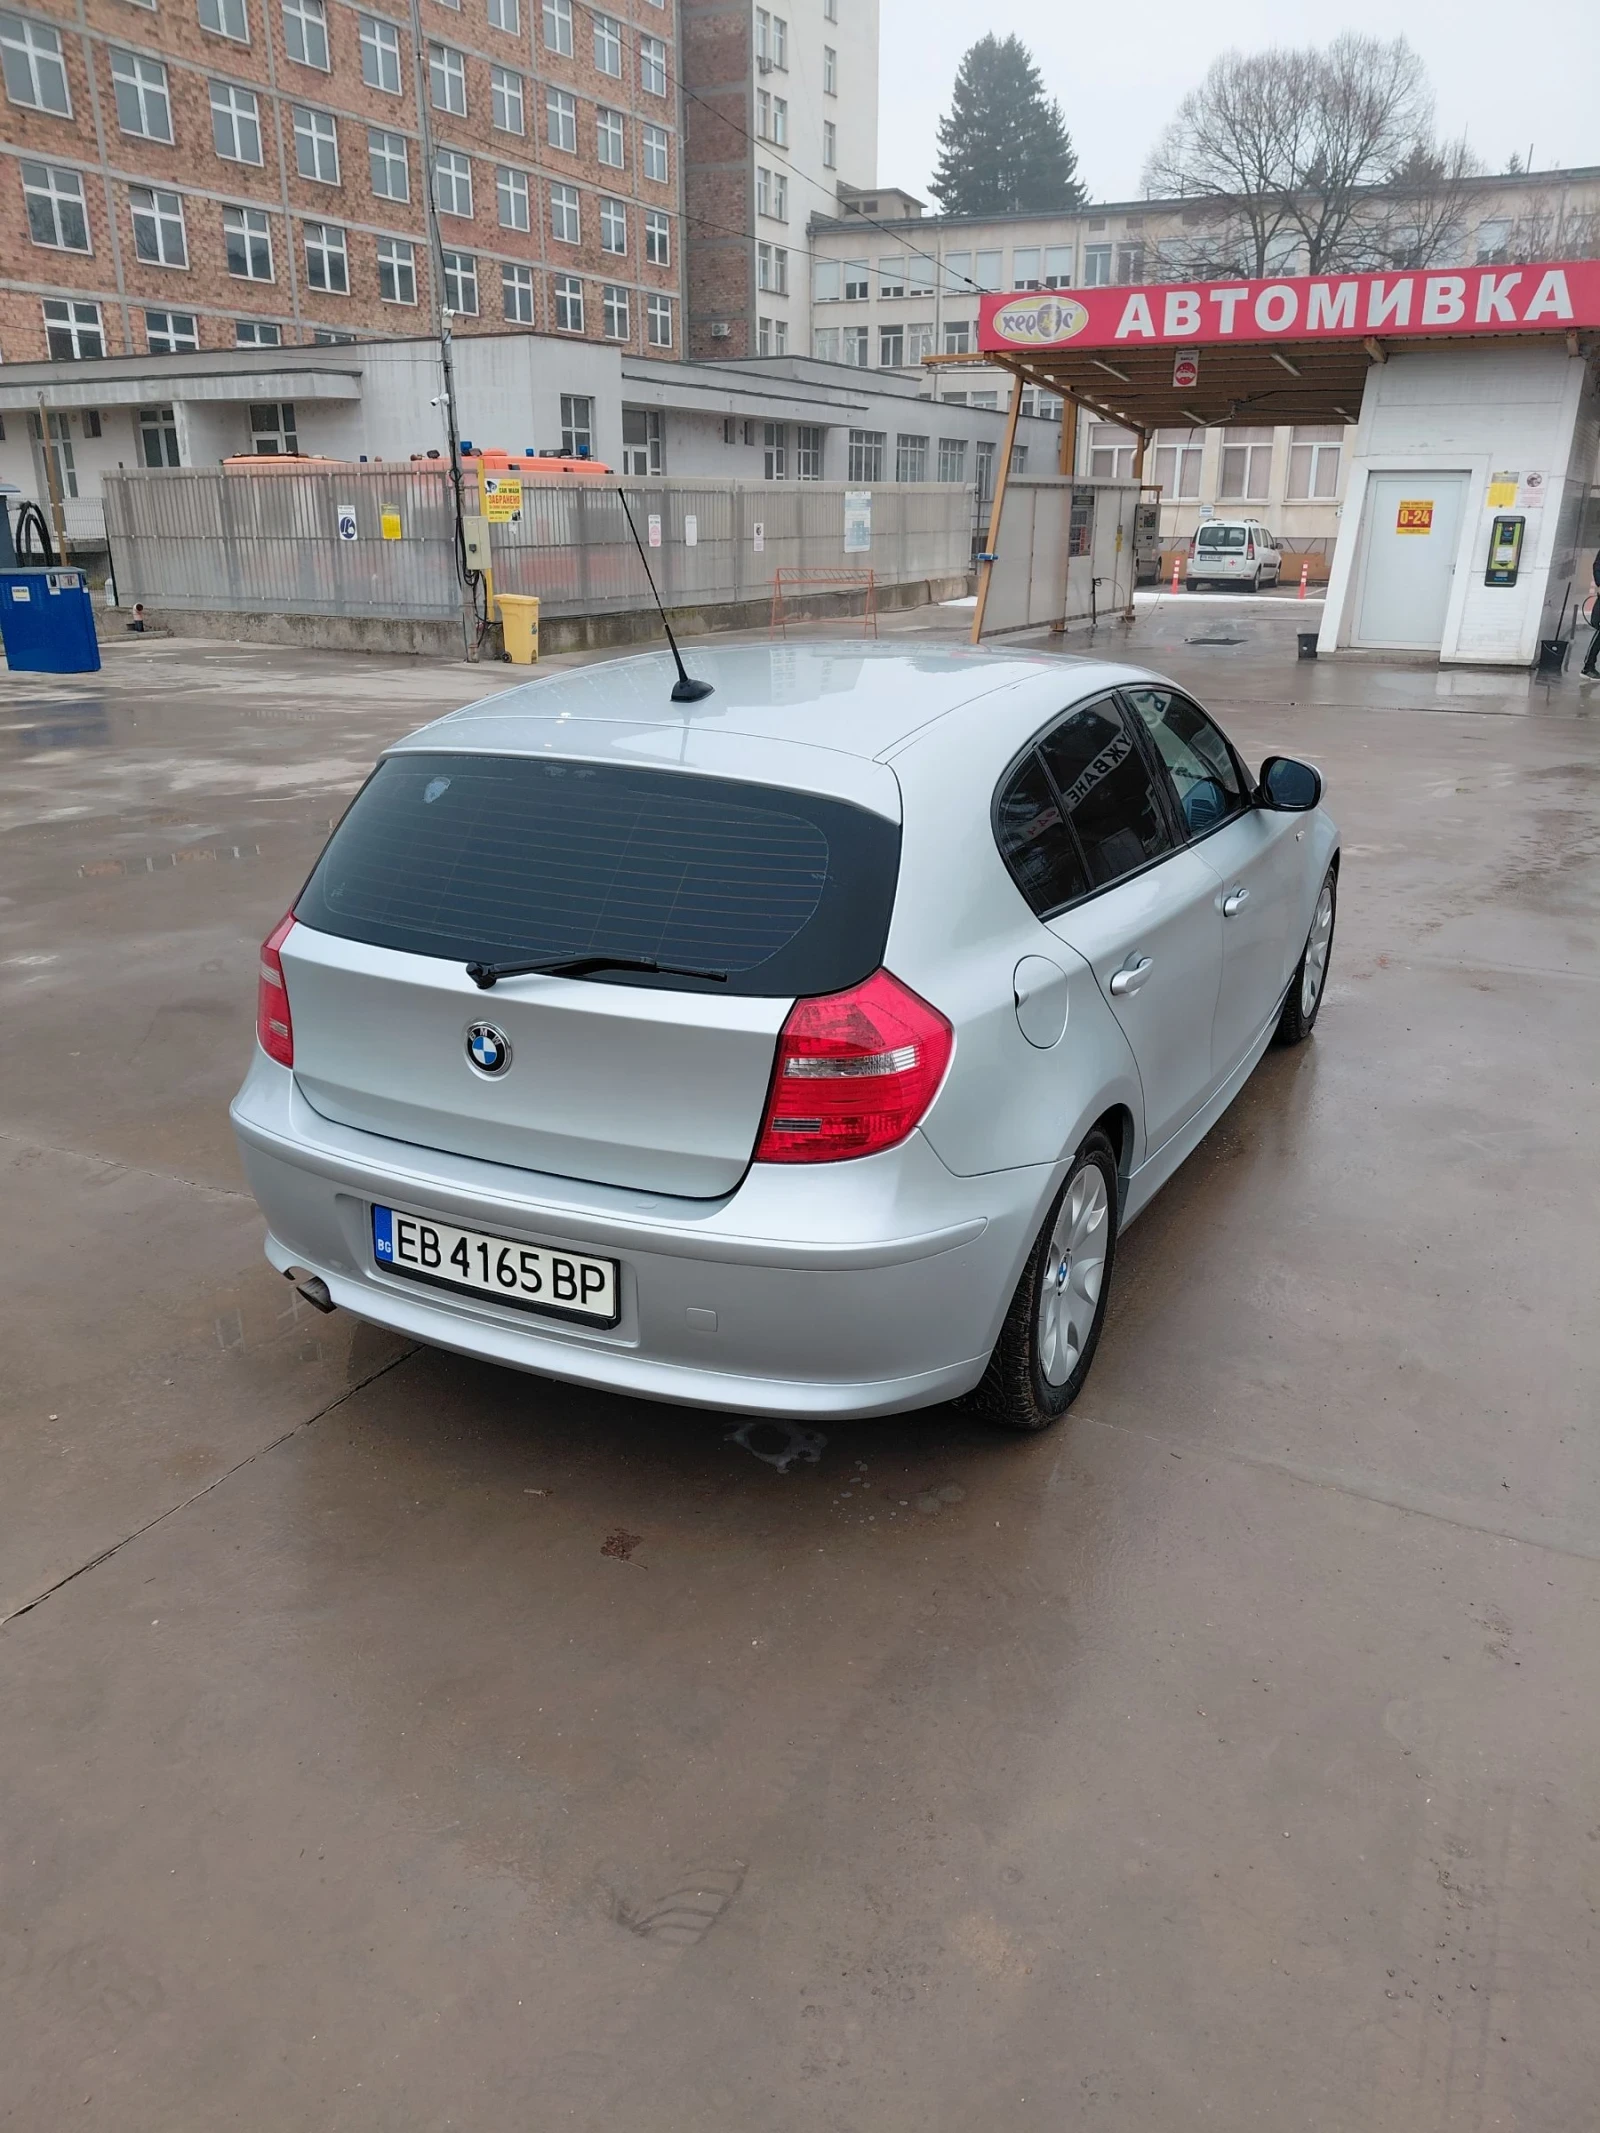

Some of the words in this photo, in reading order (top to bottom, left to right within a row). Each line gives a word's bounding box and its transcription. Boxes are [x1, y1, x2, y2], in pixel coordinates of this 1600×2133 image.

[1114, 268, 1575, 340] АВТОМИВКА
[488, 495, 520, 504] ЗАБРАНЕНО
[1400, 510, 1430, 525] 0-24
[469, 1028, 502, 1046] BMW
[377, 1238, 392, 1253] BG
[397, 1219, 442, 1268] EB
[450, 1236, 543, 1293] 4165
[552, 1258, 606, 1305] BP
